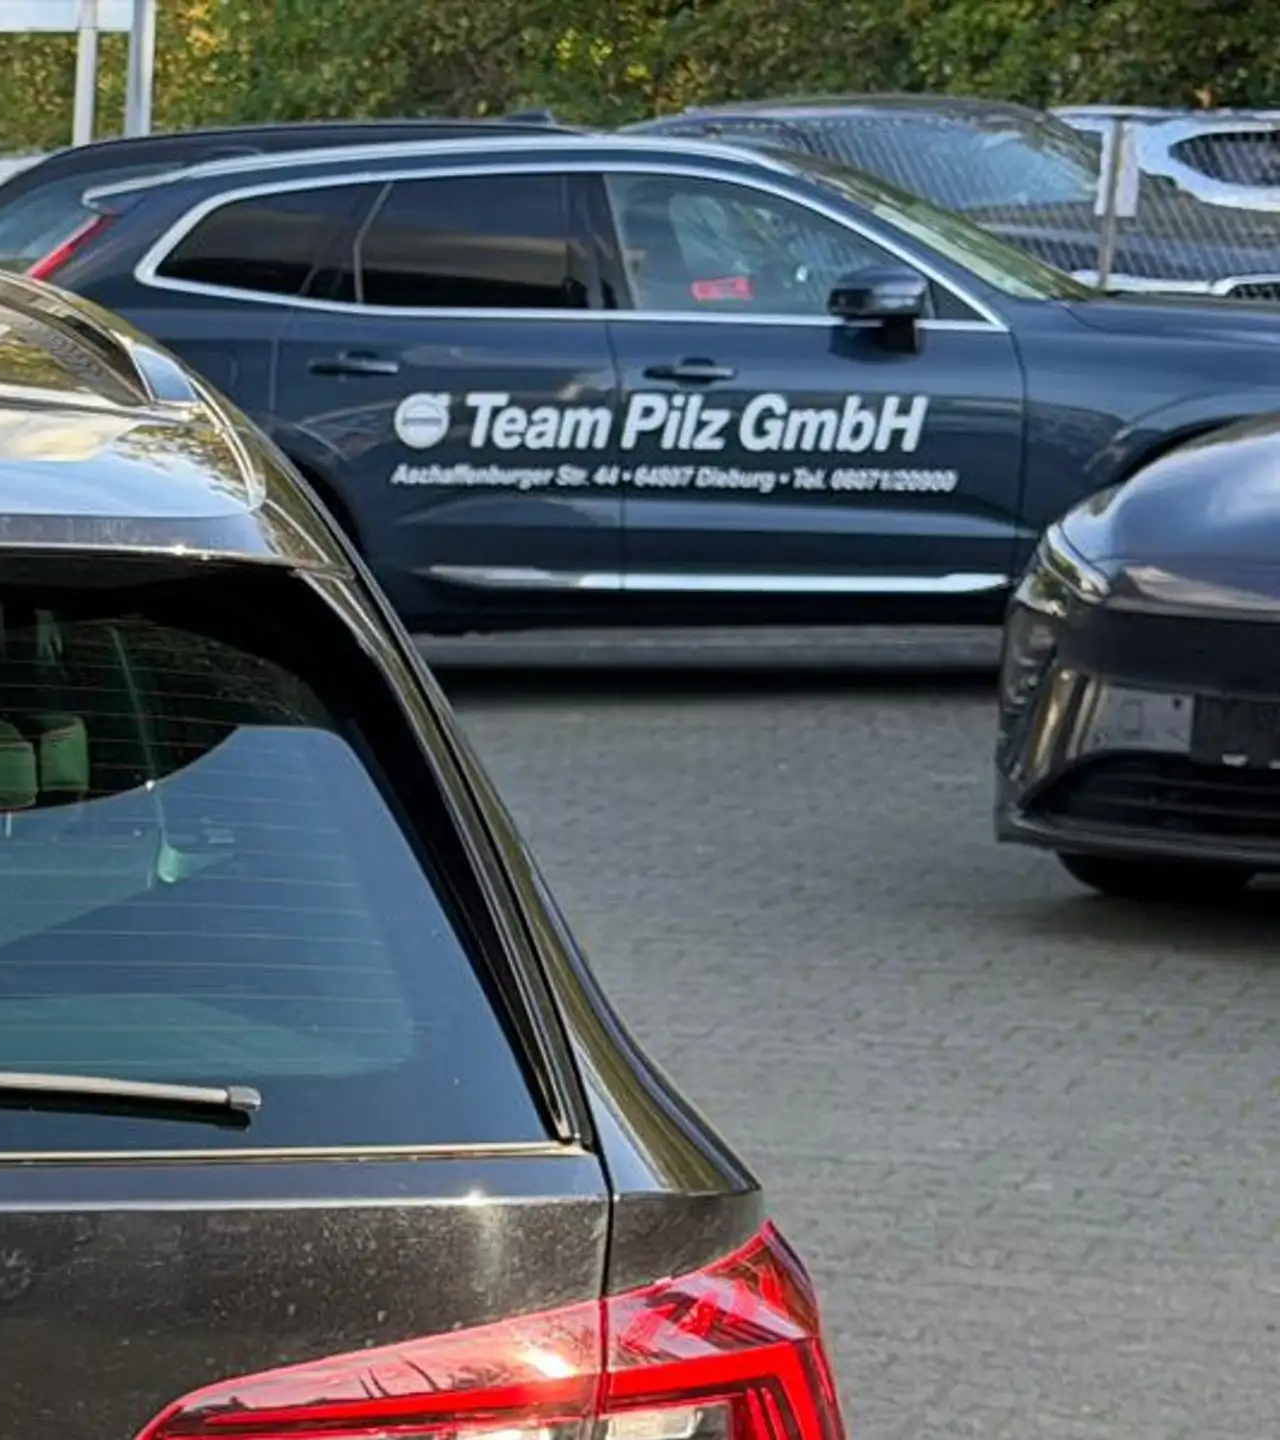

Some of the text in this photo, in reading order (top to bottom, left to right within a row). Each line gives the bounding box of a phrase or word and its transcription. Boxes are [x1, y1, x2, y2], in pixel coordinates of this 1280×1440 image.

[465, 392, 928, 452] Team Pilz GmbH
